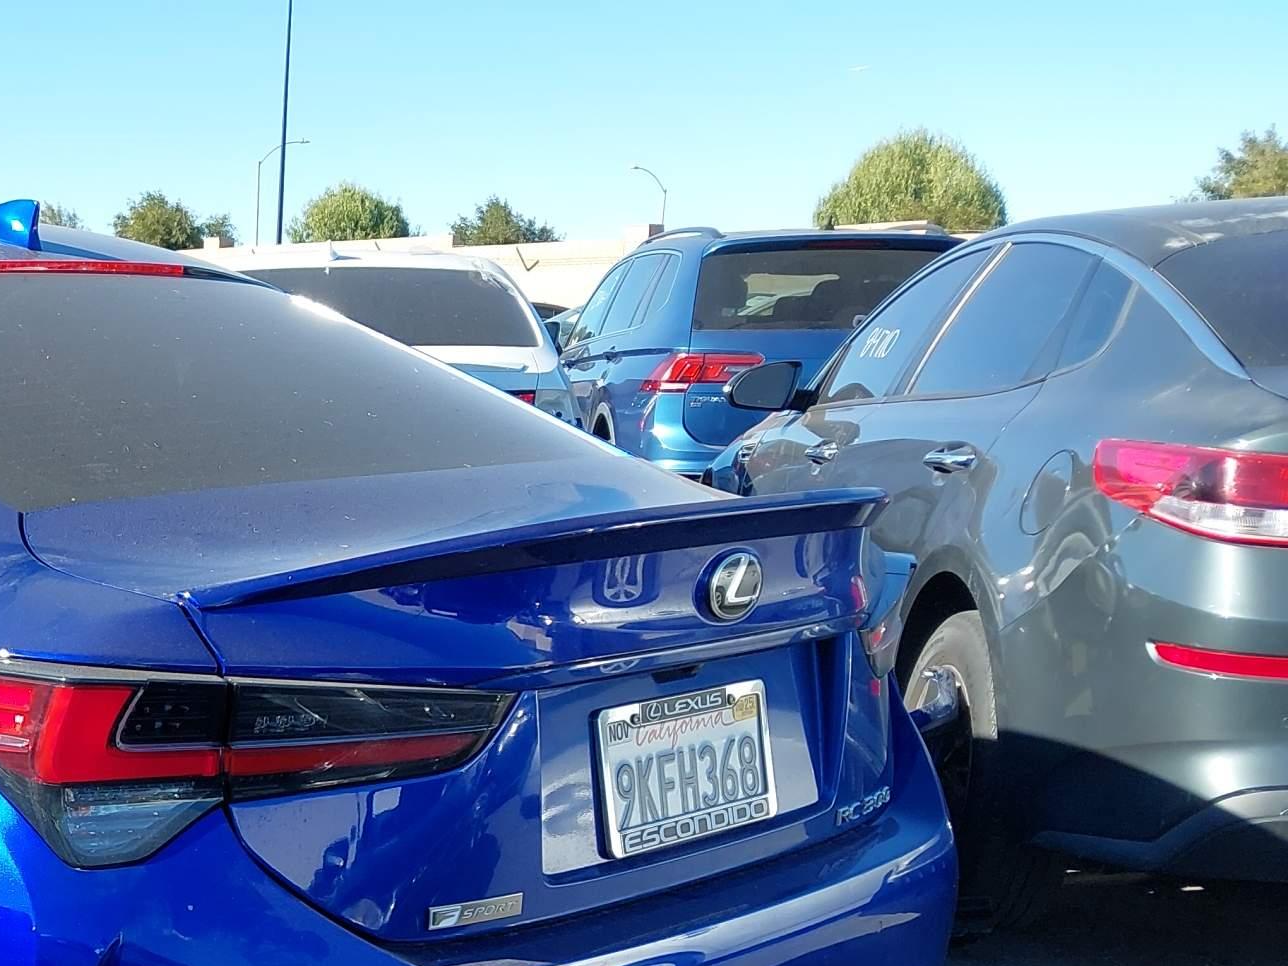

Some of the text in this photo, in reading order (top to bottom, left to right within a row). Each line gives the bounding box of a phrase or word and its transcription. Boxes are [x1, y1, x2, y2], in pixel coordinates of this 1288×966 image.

[664, 692, 722, 713] LEXUS
[609, 722, 629, 743] NOV
[635, 710, 733, 748] California
[616, 735, 760, 831] 9KFH368
[623, 800, 768, 852] ESCONDIDO
[462, 901, 517, 919] SPORT
